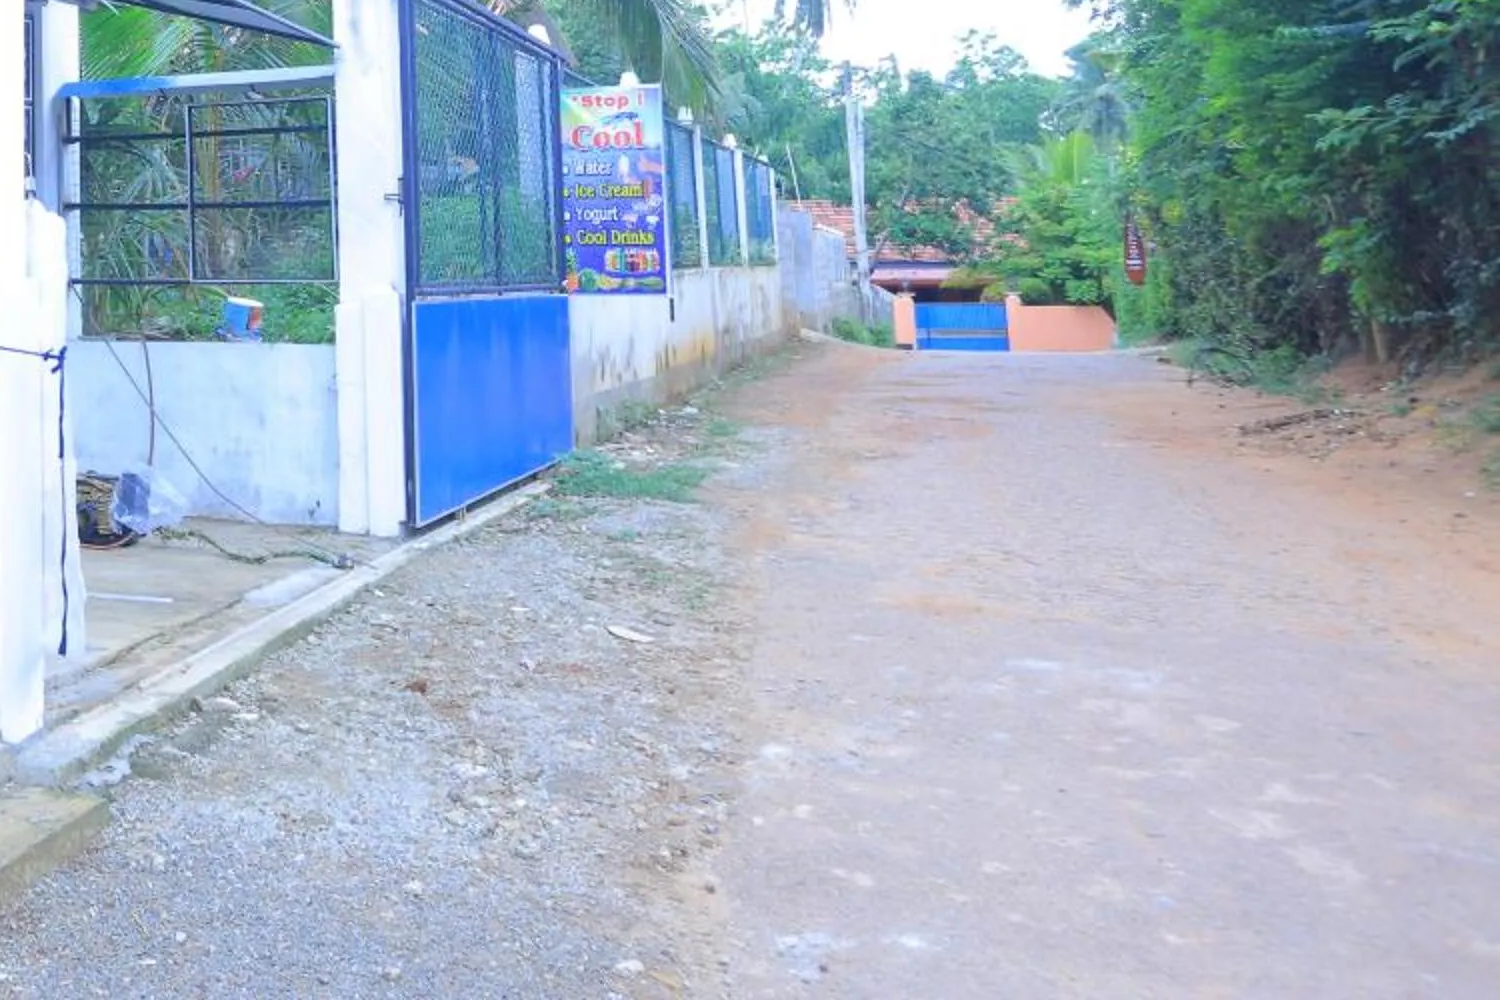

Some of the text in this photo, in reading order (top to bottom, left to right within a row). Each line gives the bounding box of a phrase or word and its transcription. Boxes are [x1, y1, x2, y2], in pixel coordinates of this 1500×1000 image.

[571, 121, 643, 149] Cool
[576, 183, 644, 198] Ice Cream
[576, 206, 618, 224] Yogurt
[578, 229, 654, 245] Cool Drinks
